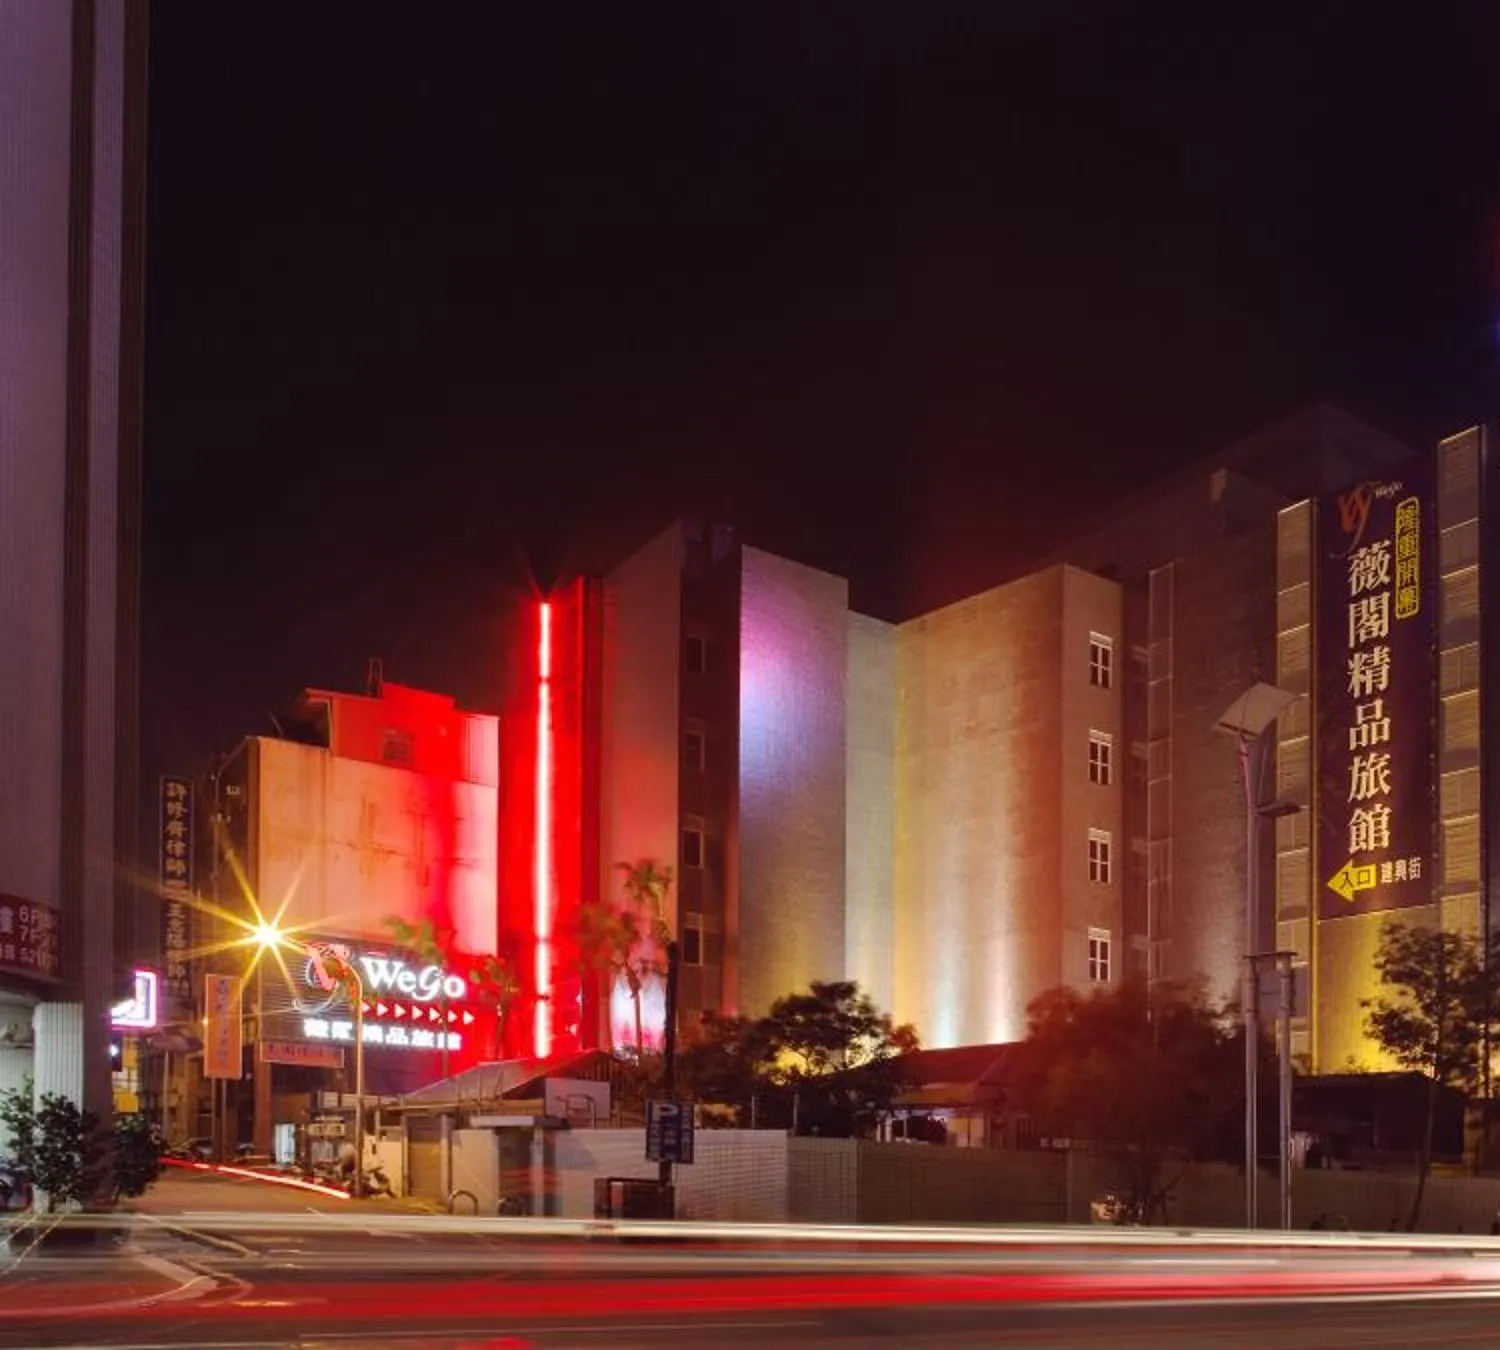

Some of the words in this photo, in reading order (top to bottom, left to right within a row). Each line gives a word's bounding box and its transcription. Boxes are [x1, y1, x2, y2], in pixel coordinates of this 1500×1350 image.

[1346, 540, 1391, 854] 薇閣精品旅館
[1339, 871, 1371, 890] 入口
